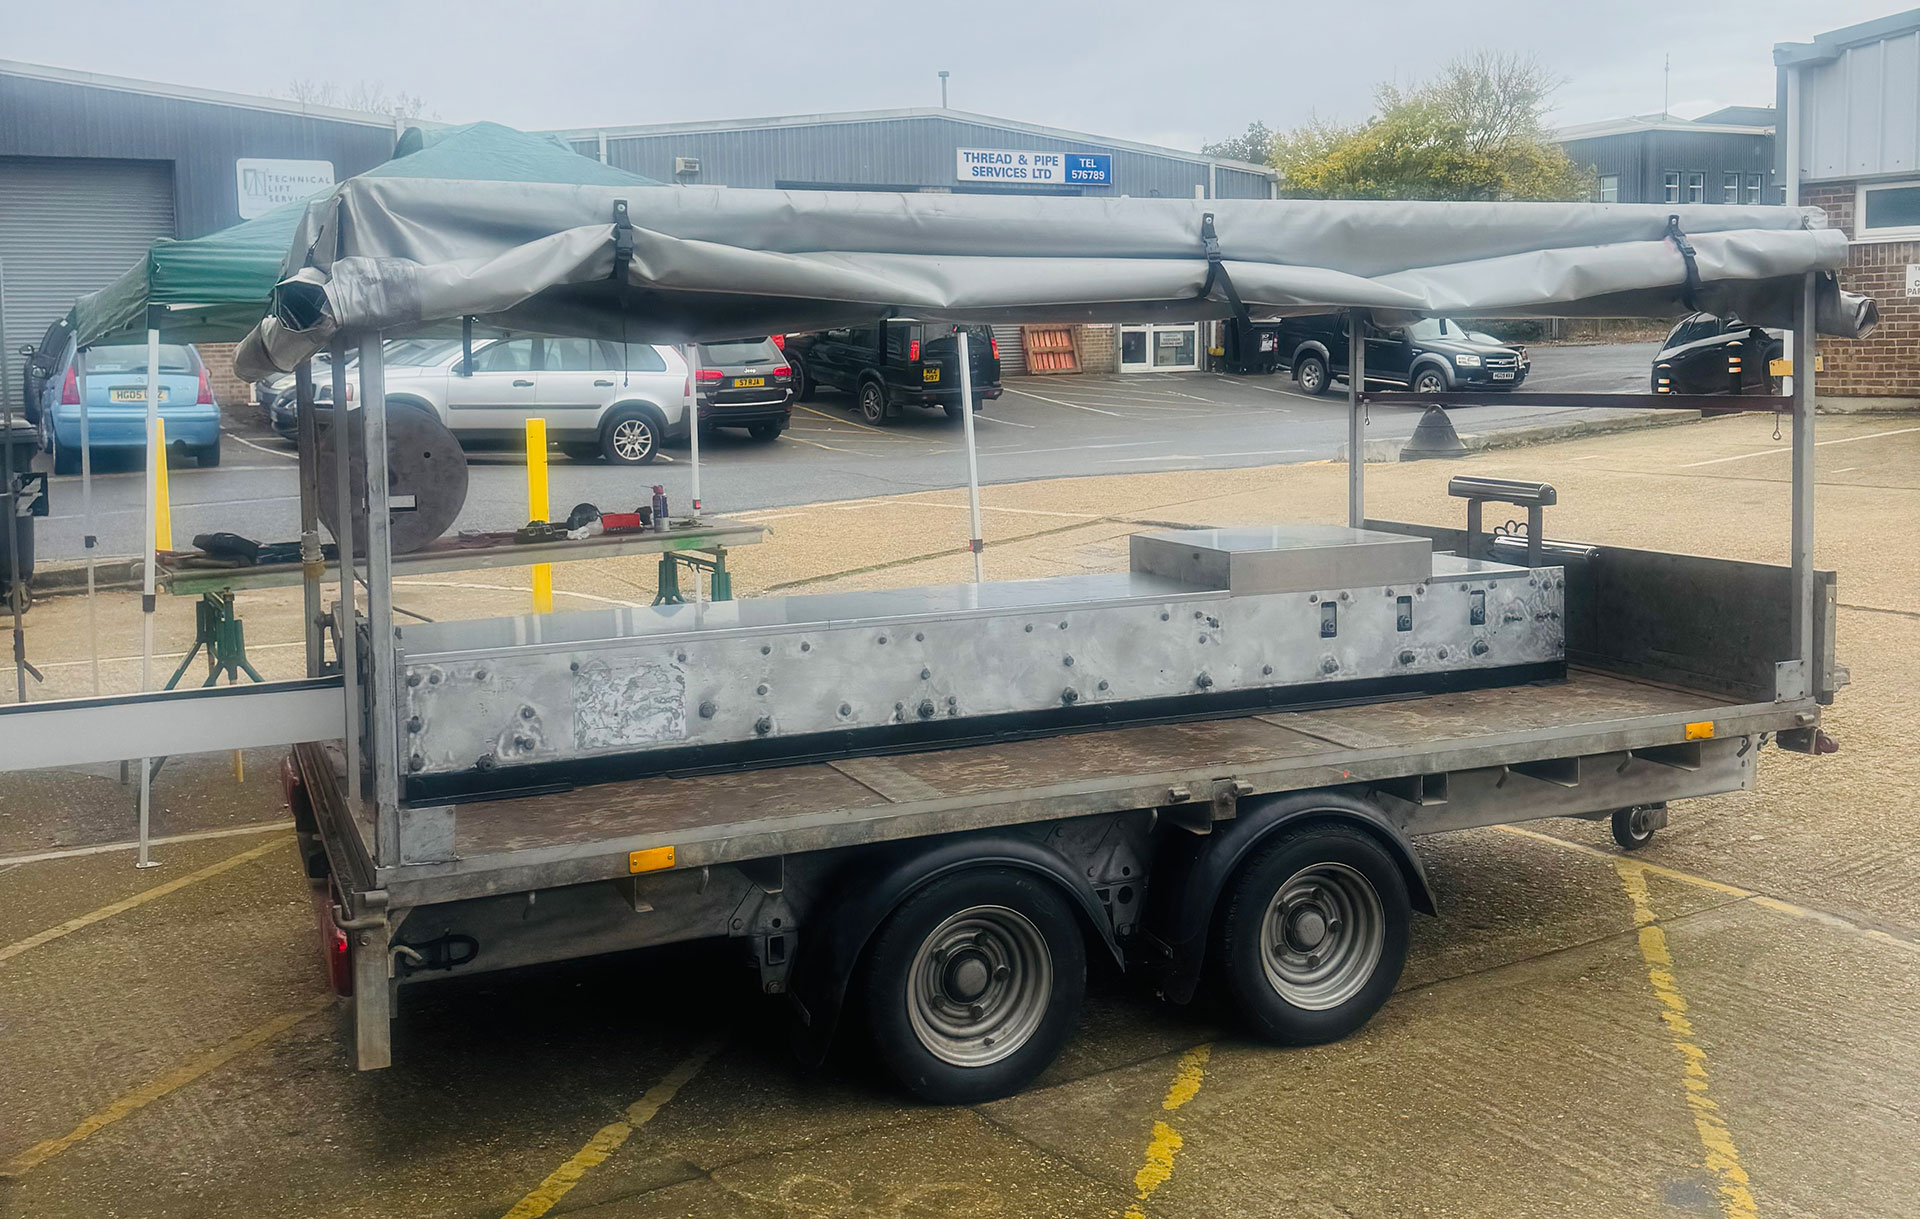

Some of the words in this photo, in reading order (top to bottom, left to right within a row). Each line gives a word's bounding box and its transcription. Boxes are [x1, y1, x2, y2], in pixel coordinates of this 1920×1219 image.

[963, 152, 1012, 165] THREAD
[1018, 154, 1028, 165] &
[1034, 155, 1059, 167] PIPE
[1079, 158, 1096, 168] TEL
[972, 166, 1027, 178] SERVICES
[1032, 168, 1052, 180] LTD
[1072, 170, 1105, 181] 576789
[268, 175, 331, 184] TECHNICAL
[268, 185, 290, 193] LIFT
